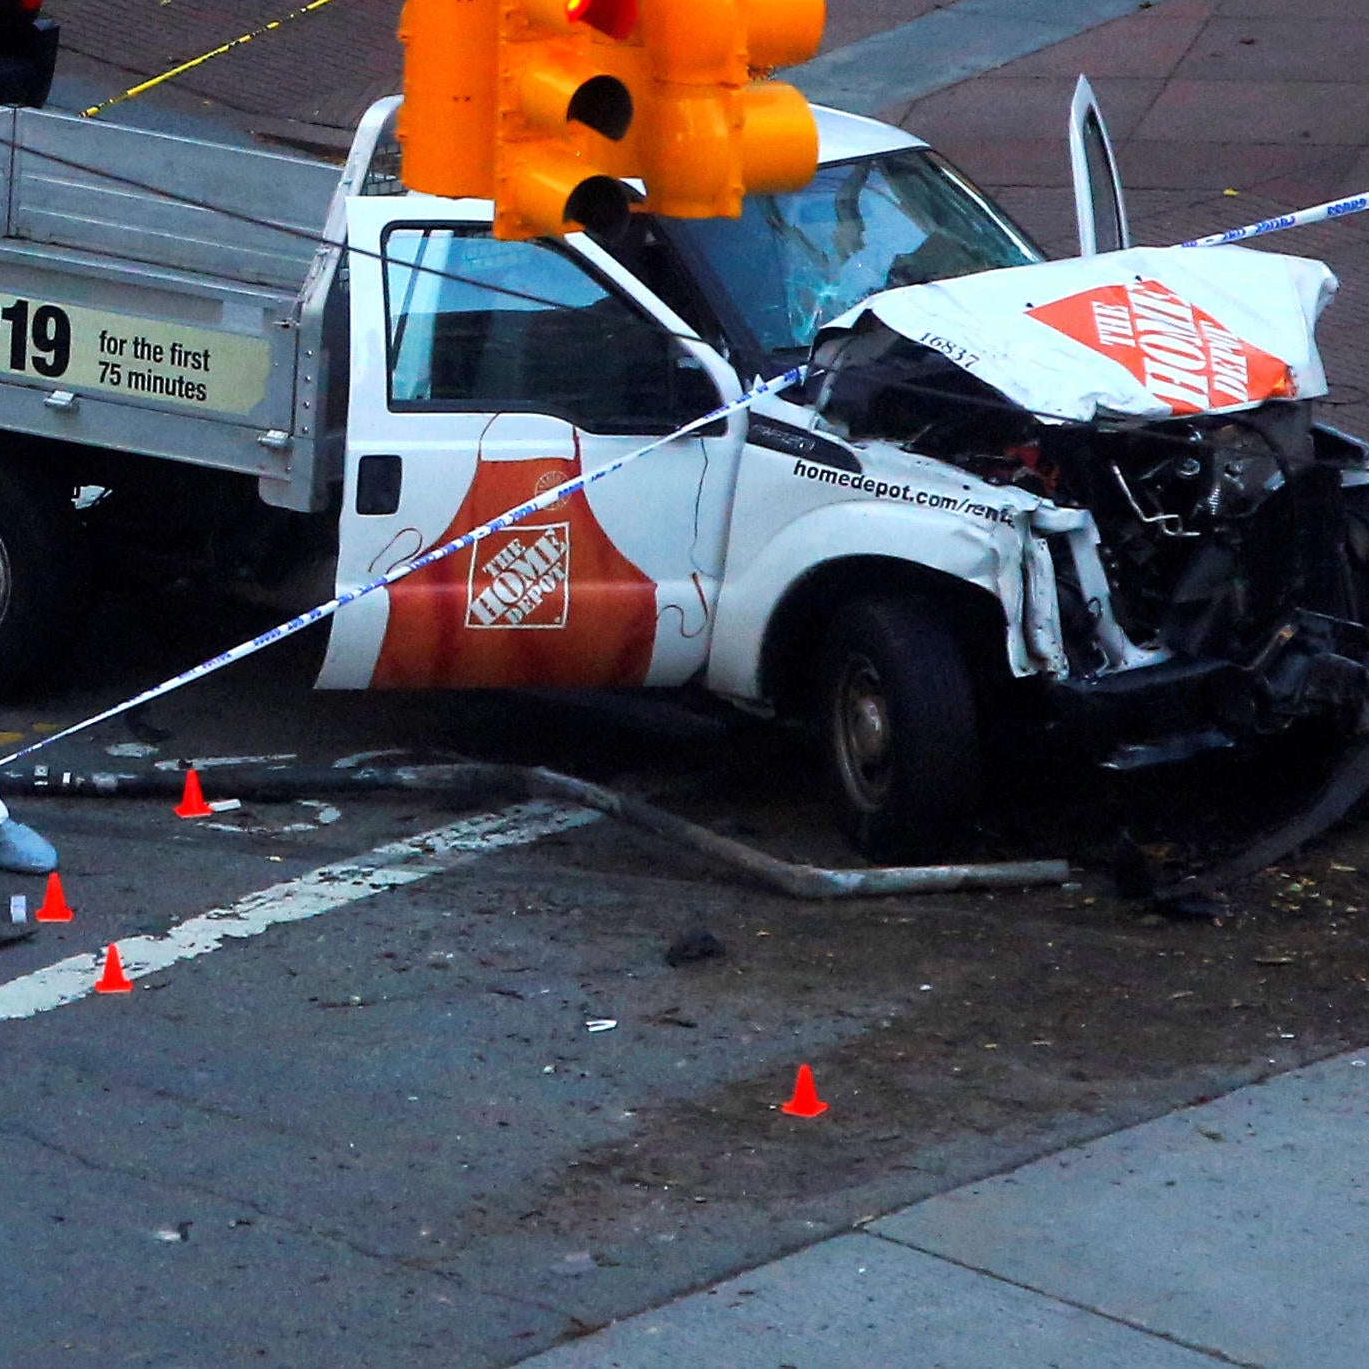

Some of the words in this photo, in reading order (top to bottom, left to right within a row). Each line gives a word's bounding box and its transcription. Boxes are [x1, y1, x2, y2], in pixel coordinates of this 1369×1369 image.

[1091, 300, 1137, 348] THE
[1126, 281, 1214, 409] HOME
[99, 330, 128, 356] for
[133, 336, 165, 363] the
[170, 343, 211, 372] first
[919, 331, 981, 370] 16837
[98, 361, 122, 386] 75
[127, 370, 208, 402] minutes
[468, 527, 569, 626] HOME
[481, 538, 526, 577] THE
[504, 562, 568, 625] DEPOT
